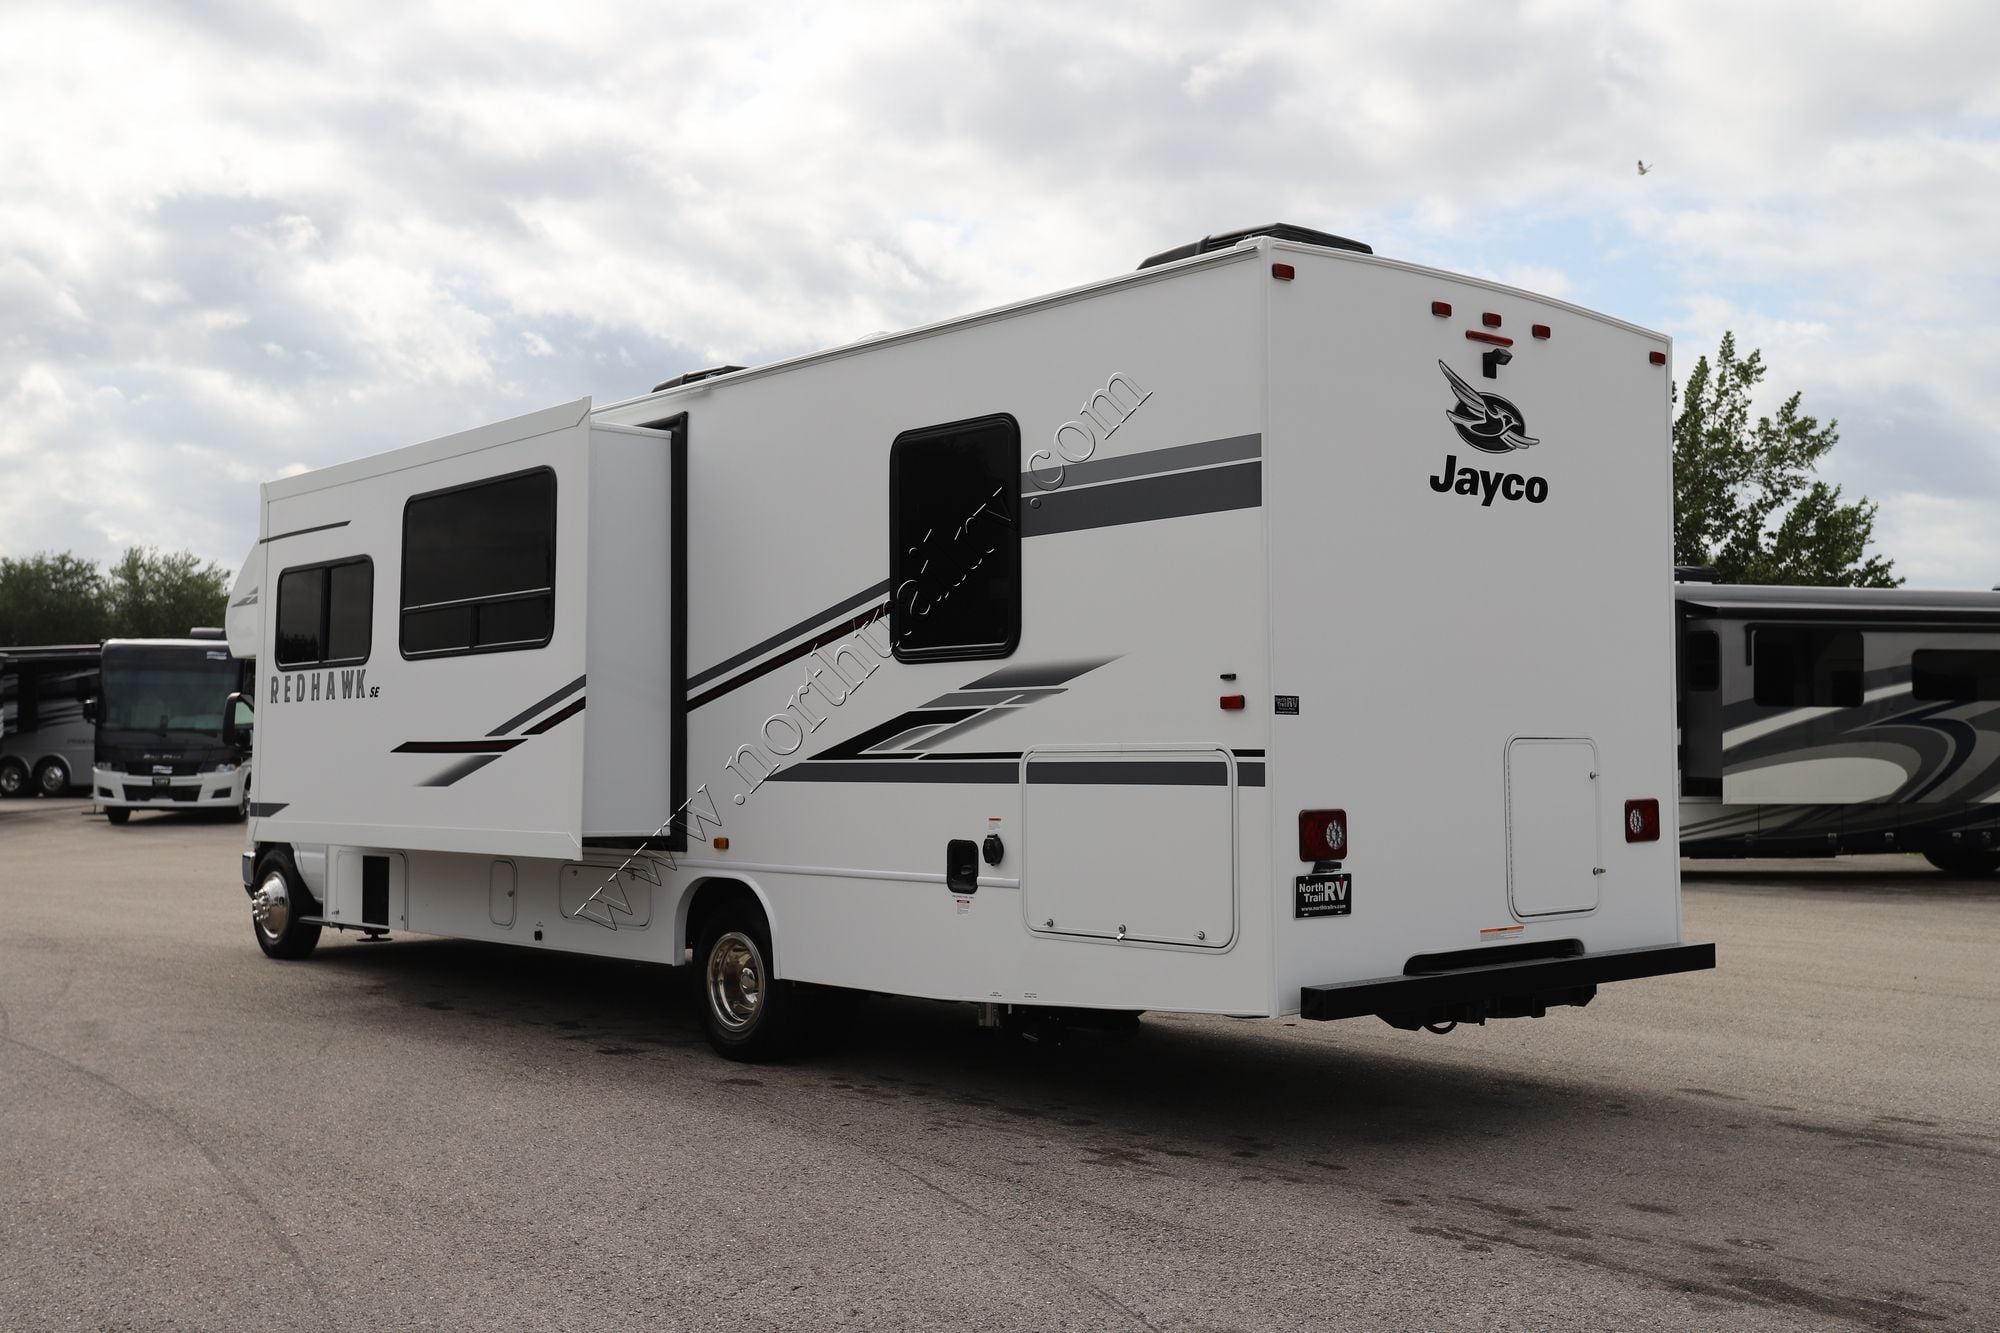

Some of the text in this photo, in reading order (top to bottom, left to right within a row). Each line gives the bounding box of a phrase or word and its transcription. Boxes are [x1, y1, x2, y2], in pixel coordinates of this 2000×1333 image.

[1429, 454, 1549, 508] Jayco
[270, 668, 380, 704] REDHAWK SE
[1298, 882, 1324, 893] North
[1303, 880, 1348, 903] Trail RV
